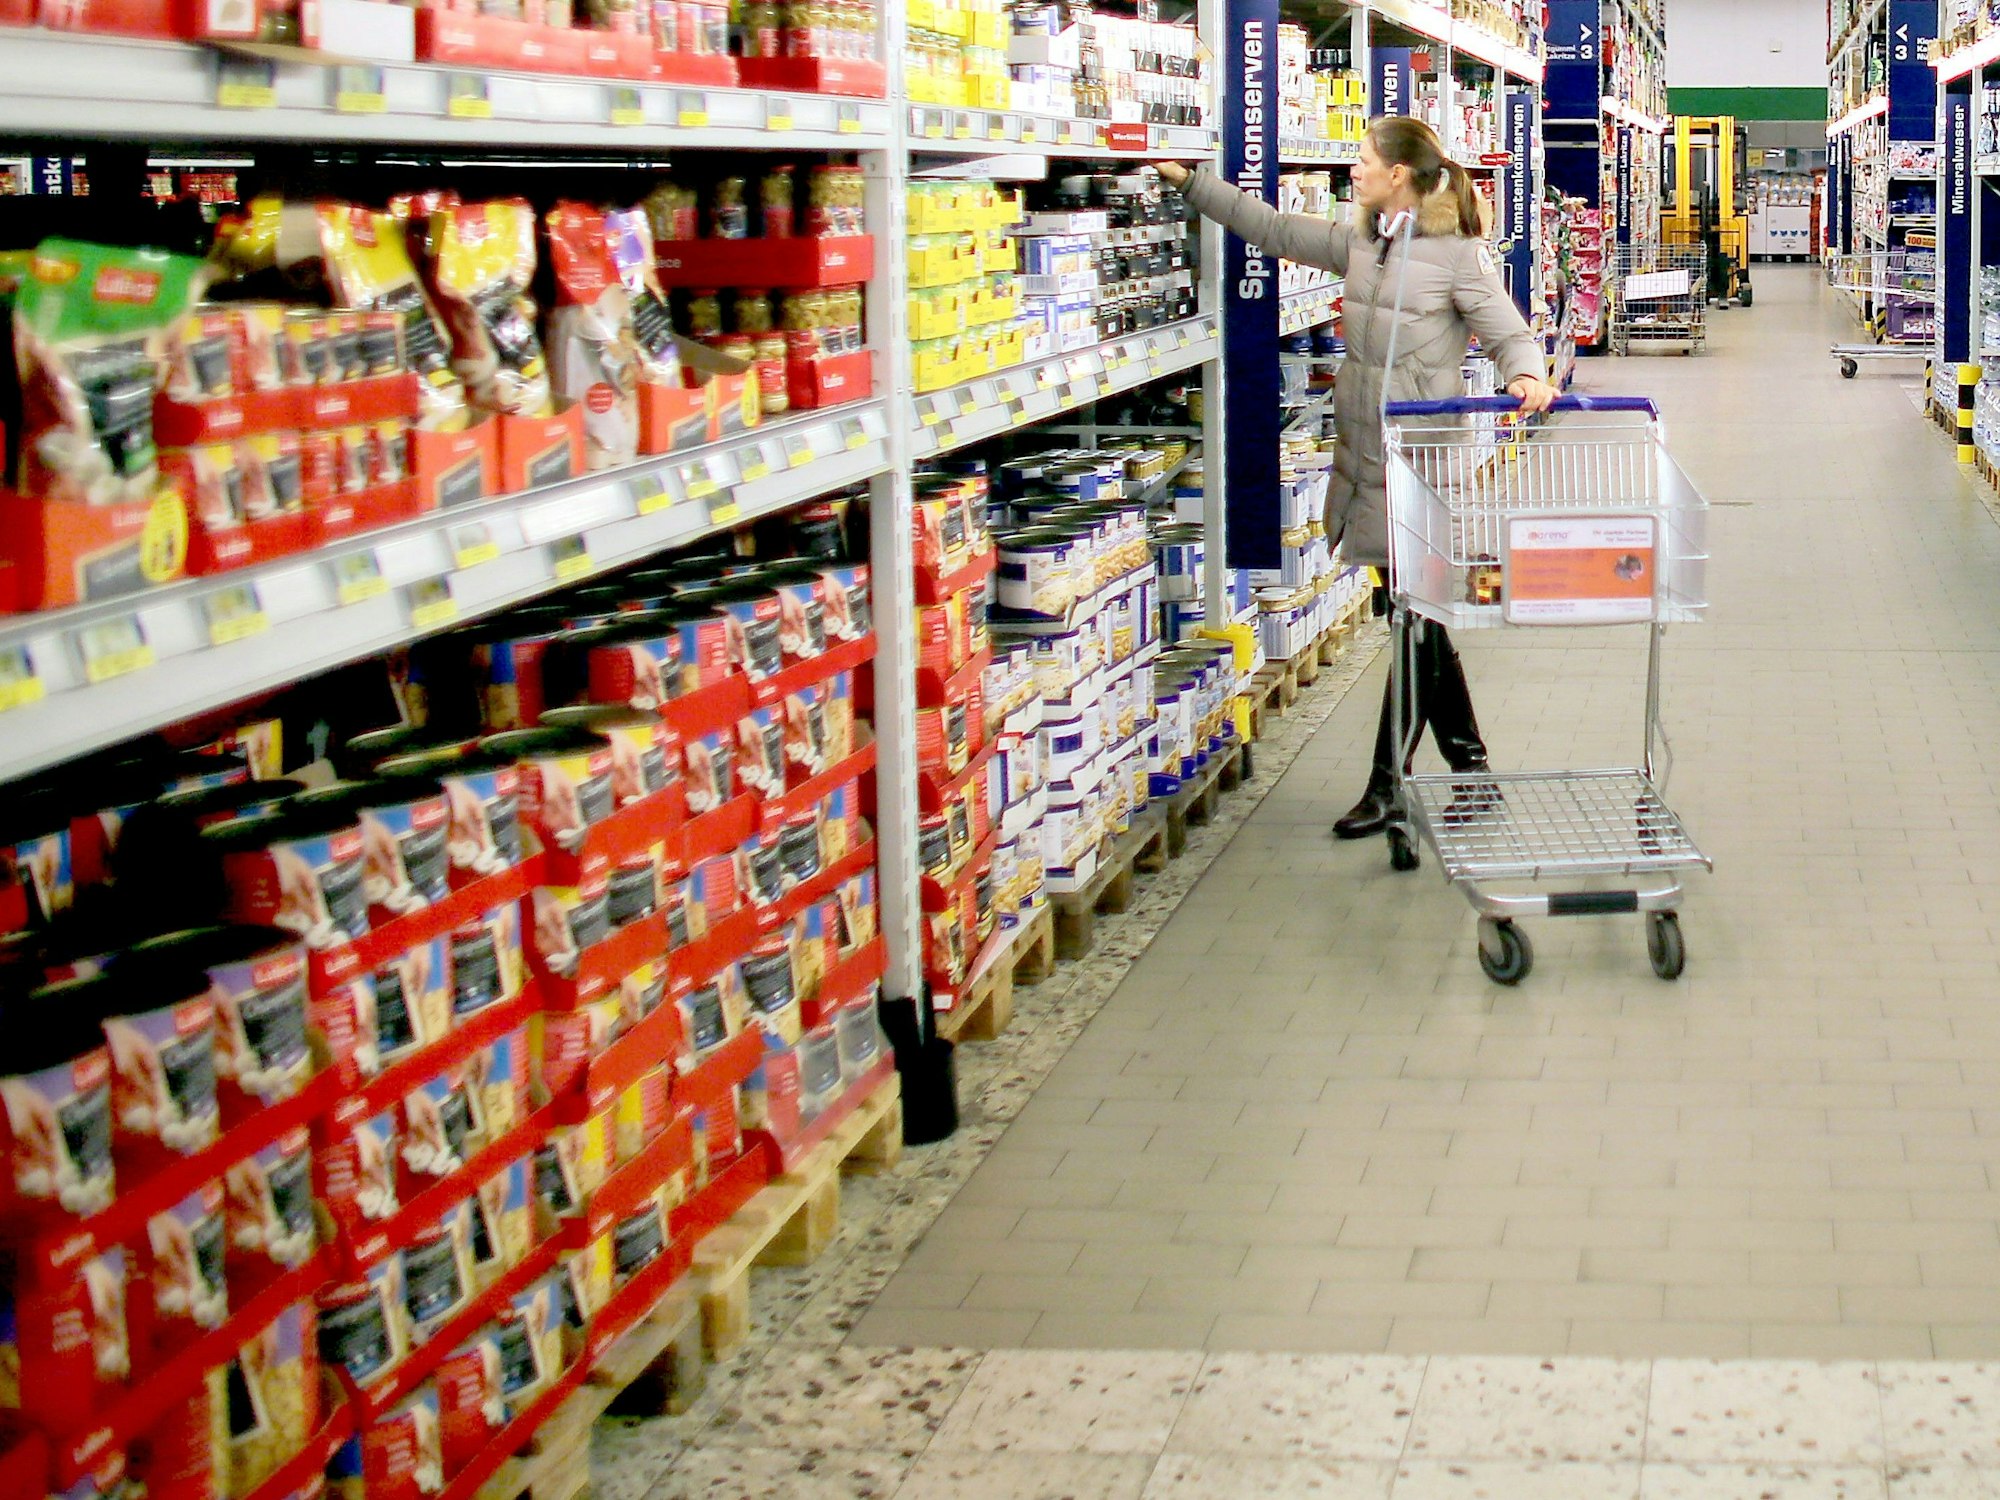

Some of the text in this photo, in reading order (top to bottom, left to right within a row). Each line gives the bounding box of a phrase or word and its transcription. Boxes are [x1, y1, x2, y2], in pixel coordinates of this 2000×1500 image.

[1580, 44, 1593, 60] 3
[1895, 45, 1908, 61] 3
[1510, 103, 1524, 242] Tomatenkonserven
[1619, 136, 1629, 227] Fruchtgummi Lakritze
[1952, 104, 1965, 215] Mineralwasser
[1907, 236, 1922, 245] 100
